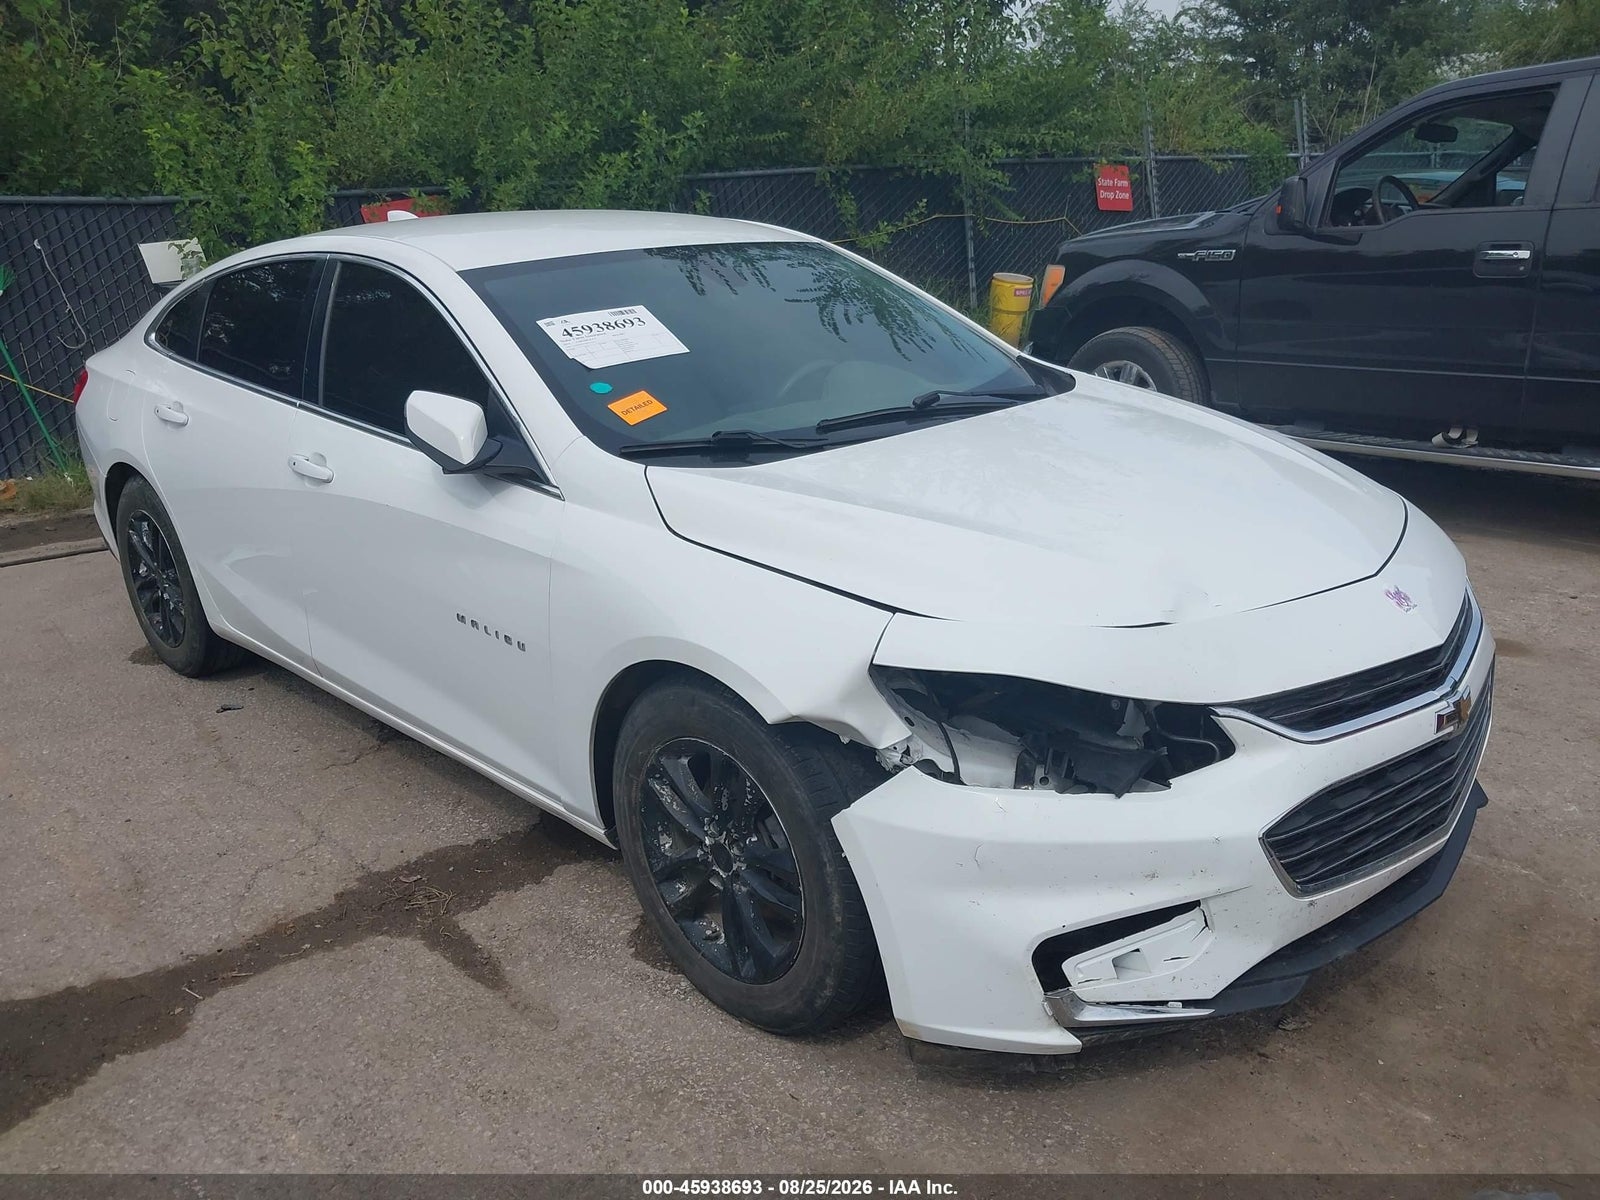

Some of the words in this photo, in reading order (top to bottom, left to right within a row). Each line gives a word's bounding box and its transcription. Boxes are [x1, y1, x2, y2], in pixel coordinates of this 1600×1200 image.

[1097, 177, 1113, 187] State
[1114, 178, 1129, 188] Farm
[1100, 190, 1115, 200] Drop
[1115, 190, 1130, 200] Zone
[561, 316, 647, 338] 45938693
[621, 399, 654, 416] DETAILED
[456, 612, 527, 652] MALIBU
